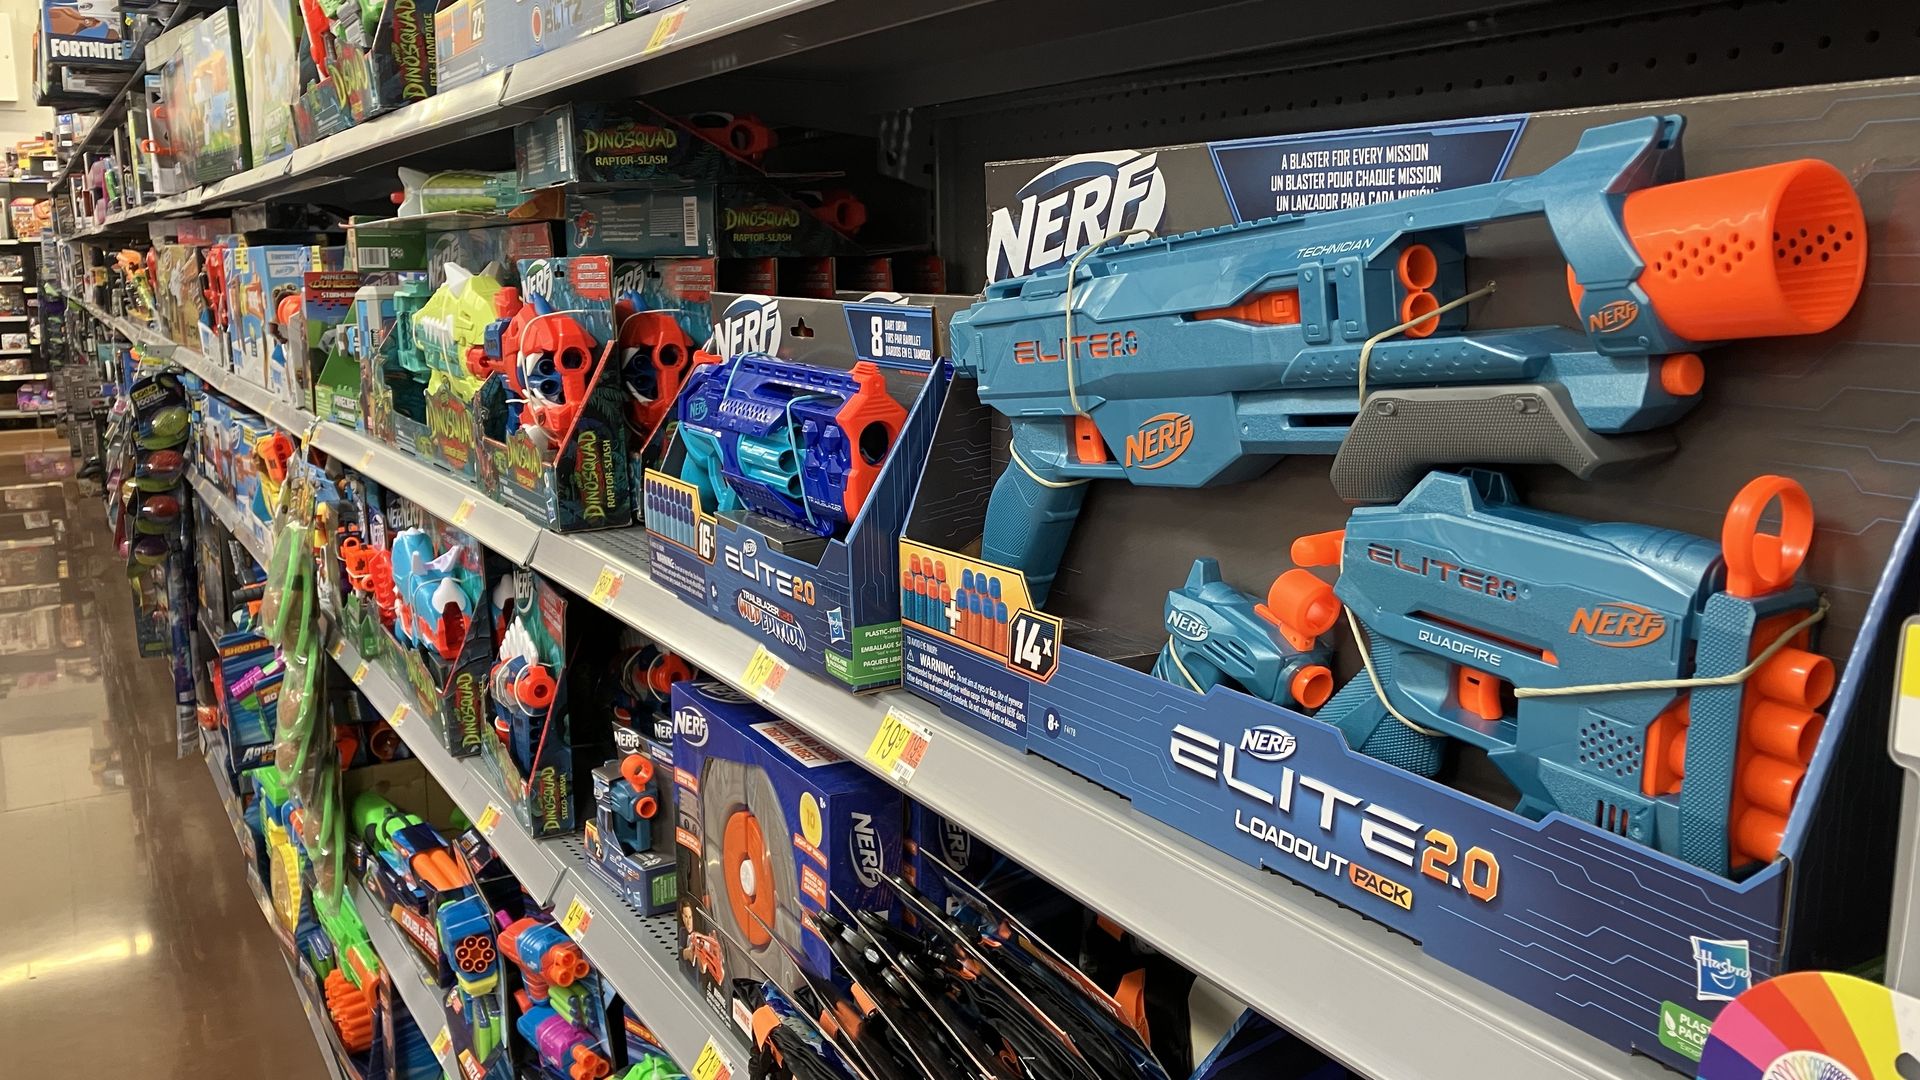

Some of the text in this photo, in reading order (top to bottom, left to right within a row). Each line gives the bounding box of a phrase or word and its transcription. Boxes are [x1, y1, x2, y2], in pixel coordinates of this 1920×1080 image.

[50, 38, 123, 60] FORTNITE
[583, 128, 677, 155] DINOSQUAD
[1281, 143, 1429, 170] A BLASTER FOR EVERY MISSION
[595, 155, 668, 166] RAPTOR-SLASH
[1271, 164, 1442, 191] UN BLASTER POUR CHAQUE MISSION
[1276, 195, 1289, 212] UN
[1291, 193, 1339, 212] LANZADOR
[1341, 191, 1366, 209] PARA
[1368, 190, 1395, 206] CADA
[724, 207, 800, 231] DINOSQUAD
[987, 151, 1160, 284] NERF
[1297, 237, 1375, 260] TECHNICIAN
[714, 299, 779, 364] NERF
[885, 319, 907, 332] DART DRUM
[1589, 302, 1639, 331] NERF
[871, 316, 884, 357] 8
[1013, 332, 1110, 365] ELITE
[691, 400, 707, 417] NERF
[1126, 414, 1194, 468] NERF
[578, 430, 606, 520] DINOSQUAD
[606, 439, 616, 508] RAPTOR-SLASH
[725, 545, 794, 597] ELITE
[792, 576, 815, 607] 2.0
[1367, 542, 1486, 592] ELITE
[741, 588, 779, 616] TRAILBLAZER
[761, 607, 807, 652] EDITION
[1167, 608, 1209, 640] NERF
[1568, 606, 1666, 641] NERF
[861, 642, 895, 653] EMBALLAGE
[863, 657, 888, 667] PAQUETE
[1418, 629, 1502, 667] QUADFIRE
[919, 652, 956, 680] WARNING:
[457, 673, 481, 748] DINOSQUAD
[674, 710, 708, 737] NERF
[1047, 713, 1060, 732] 8+
[614, 730, 640, 748] NERF
[1240, 727, 1296, 755] NERF
[541, 766, 560, 832] DINOSQUAD
[1170, 724, 1500, 903] ELITE 2.0
[851, 811, 882, 884] NERF
[943, 817, 970, 867] ERF
[1235, 809, 1409, 906] LOADOUT PACK
[1694, 949, 1752, 979] Hasbro
